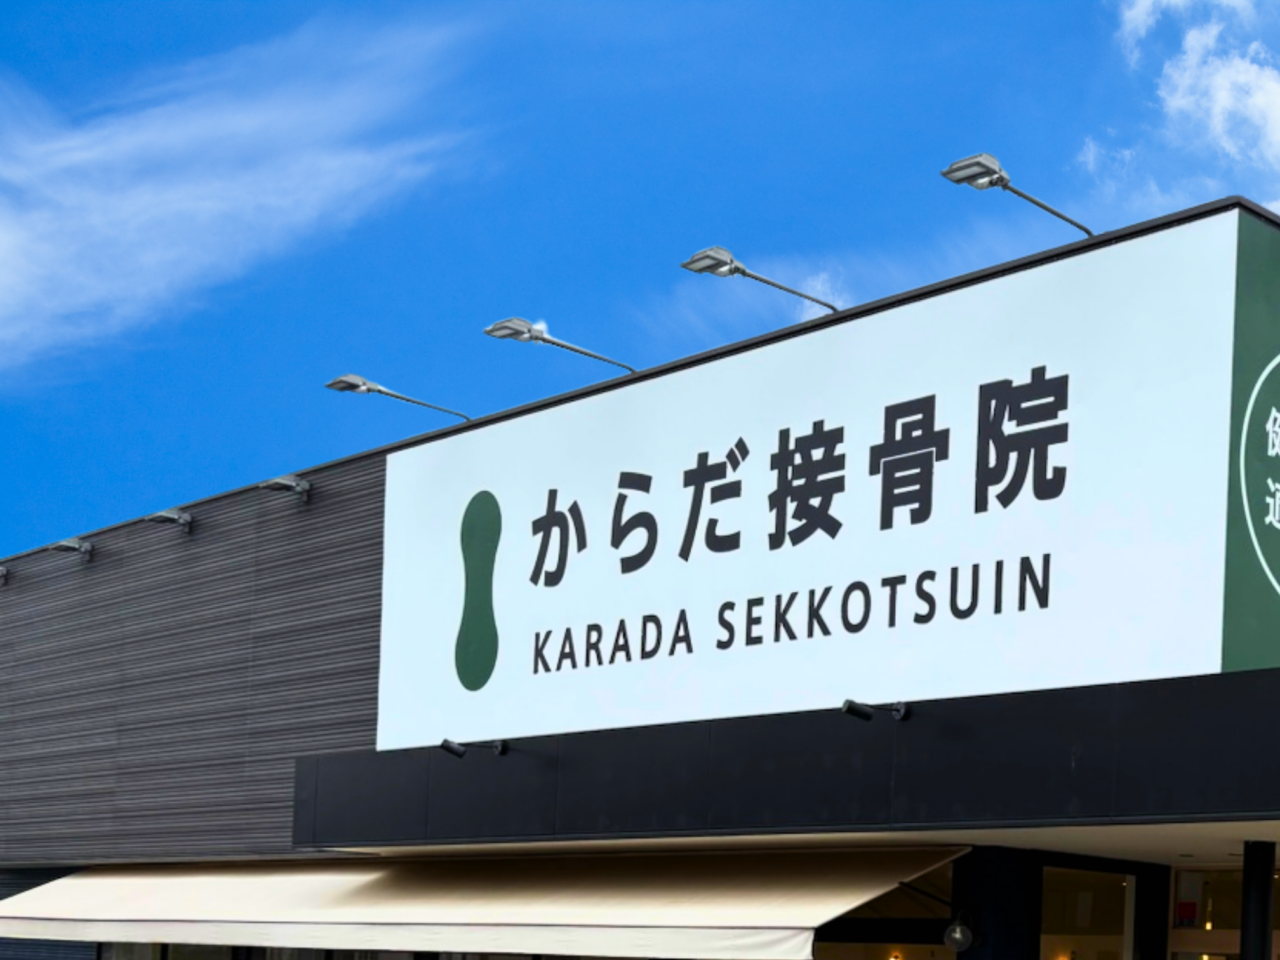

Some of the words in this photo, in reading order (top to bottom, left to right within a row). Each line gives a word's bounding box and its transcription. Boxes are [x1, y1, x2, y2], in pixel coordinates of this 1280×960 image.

[529, 366, 1069, 587] からだ接骨院
[534, 608, 693, 674] KARADA
[717, 554, 1052, 650] SEKKOTSUIN
